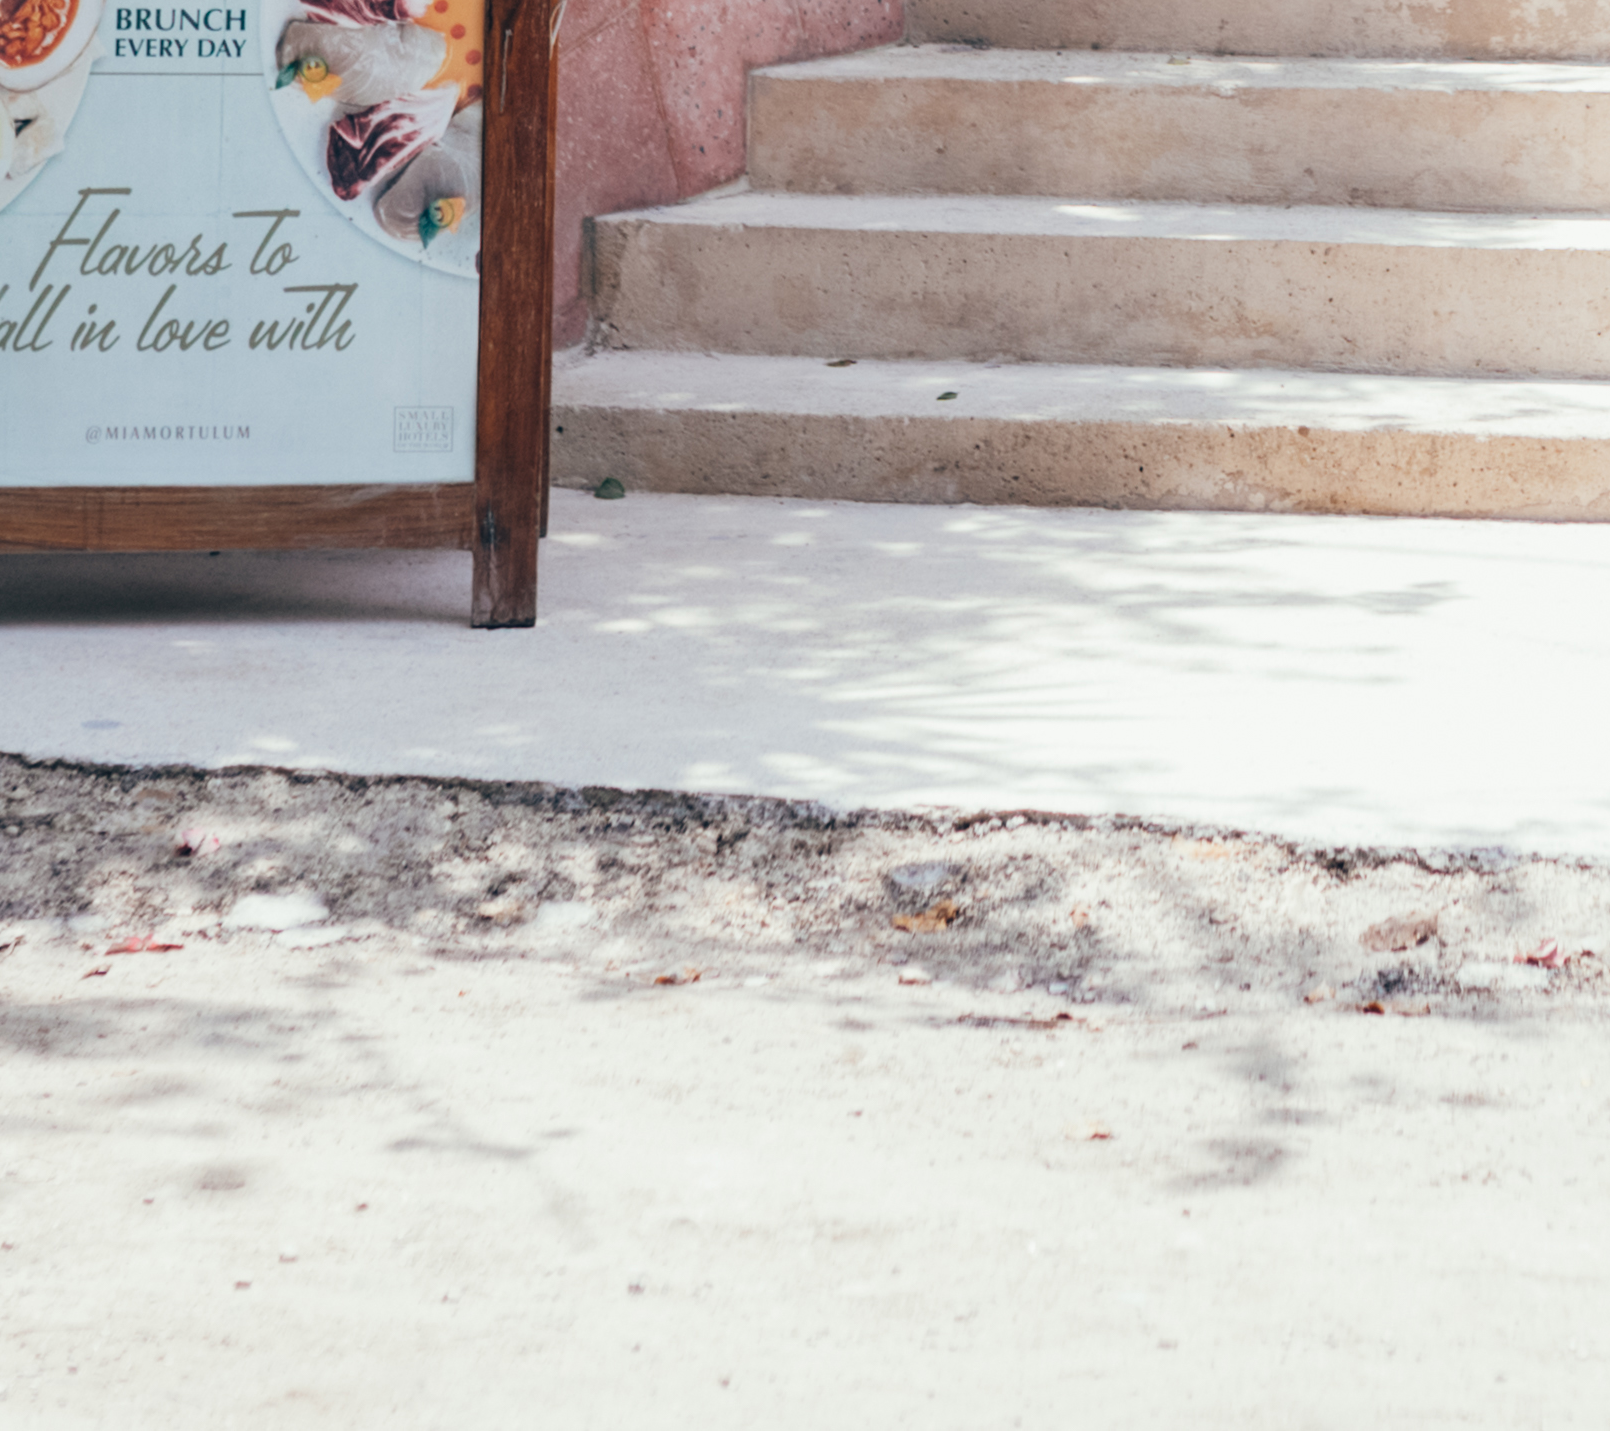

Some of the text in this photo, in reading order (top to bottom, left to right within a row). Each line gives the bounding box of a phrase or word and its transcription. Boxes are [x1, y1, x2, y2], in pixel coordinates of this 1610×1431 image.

[115, 8, 247, 31] BRUNCH
[115, 38, 247, 58] EVERY DAY
[28, 187, 233, 292] Flavors
[70, 302, 120, 352] in
[136, 283, 233, 352] love
[248, 282, 359, 352] with
[398, 411, 450, 420] SMALL
[85, 425, 251, 445] @MIAMORTULUM
